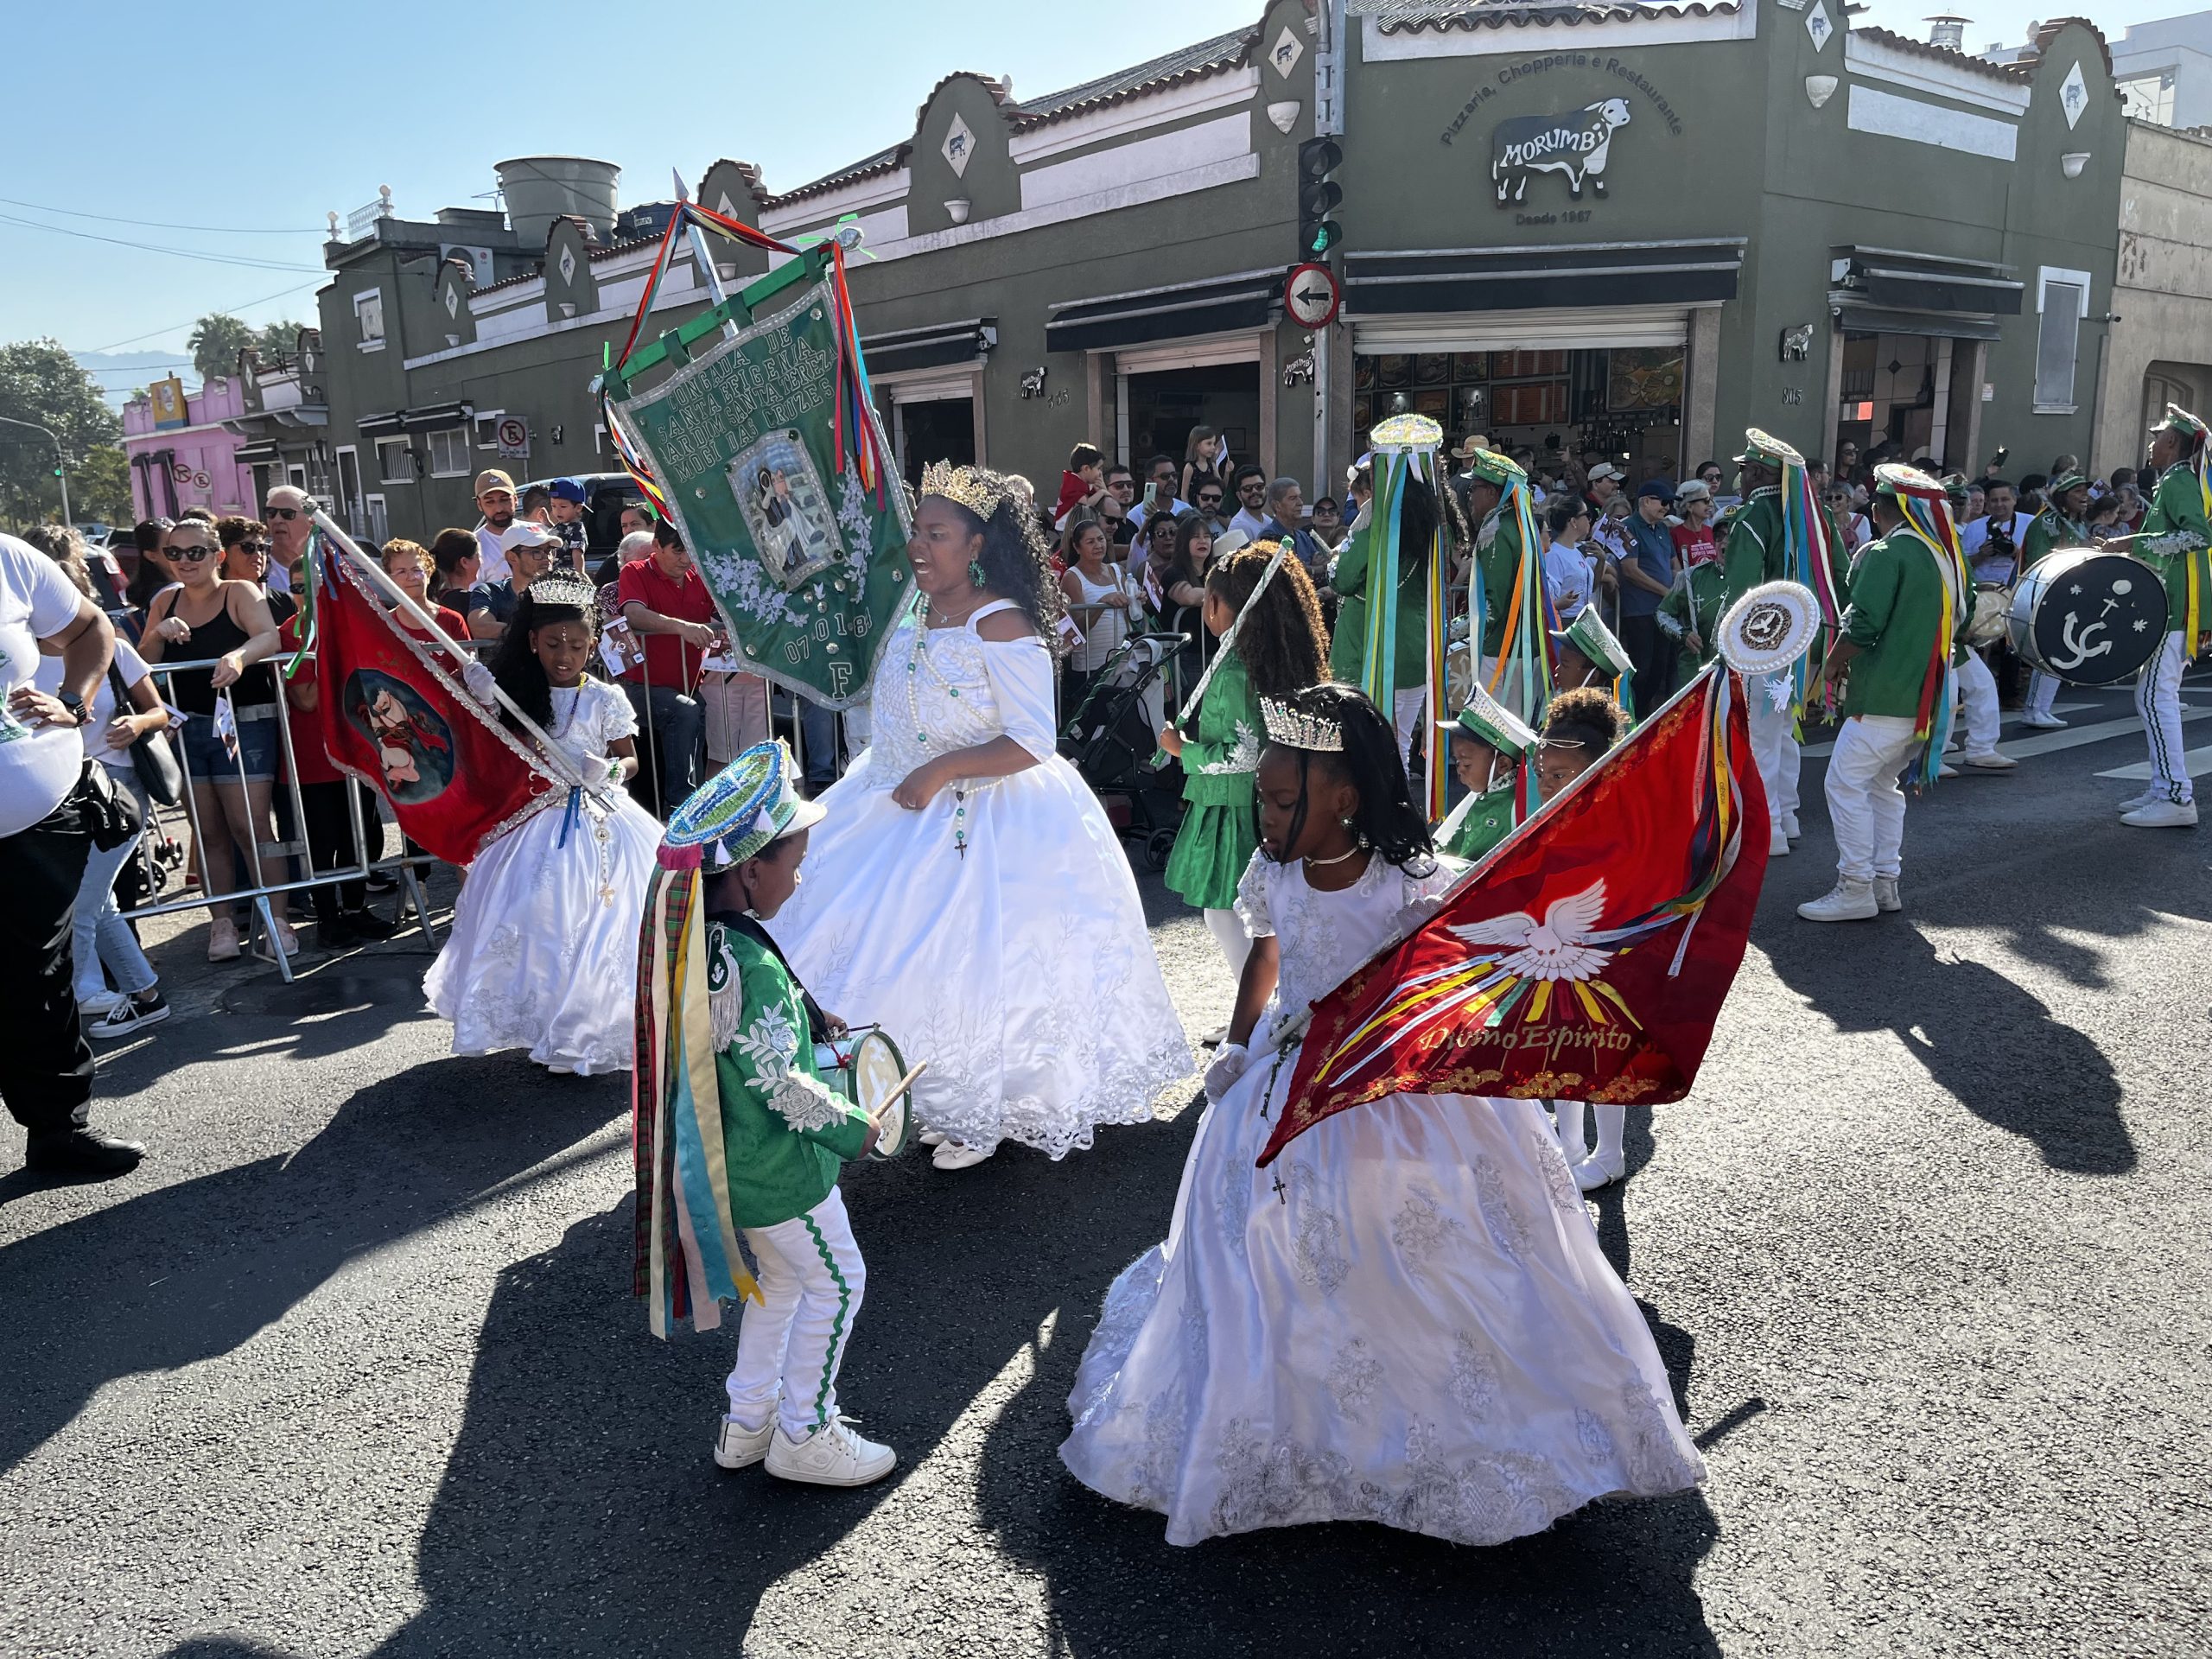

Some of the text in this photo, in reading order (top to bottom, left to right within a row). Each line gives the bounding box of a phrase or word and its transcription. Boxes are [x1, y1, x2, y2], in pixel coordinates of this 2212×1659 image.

[1440, 53, 1681, 145] Pizzaria, Chopperia e Restaurante
[657, 336, 817, 444] SANTA EFIGENIA
[667, 325, 792, 413] CONGADA DE
[673, 378, 835, 484] MOGI DAS CRUZES
[723, 383, 784, 427] SANTA
[785, 634, 810, 664] 07
[829, 662, 853, 699] F
[1419, 1027, 1518, 1050] Divino
